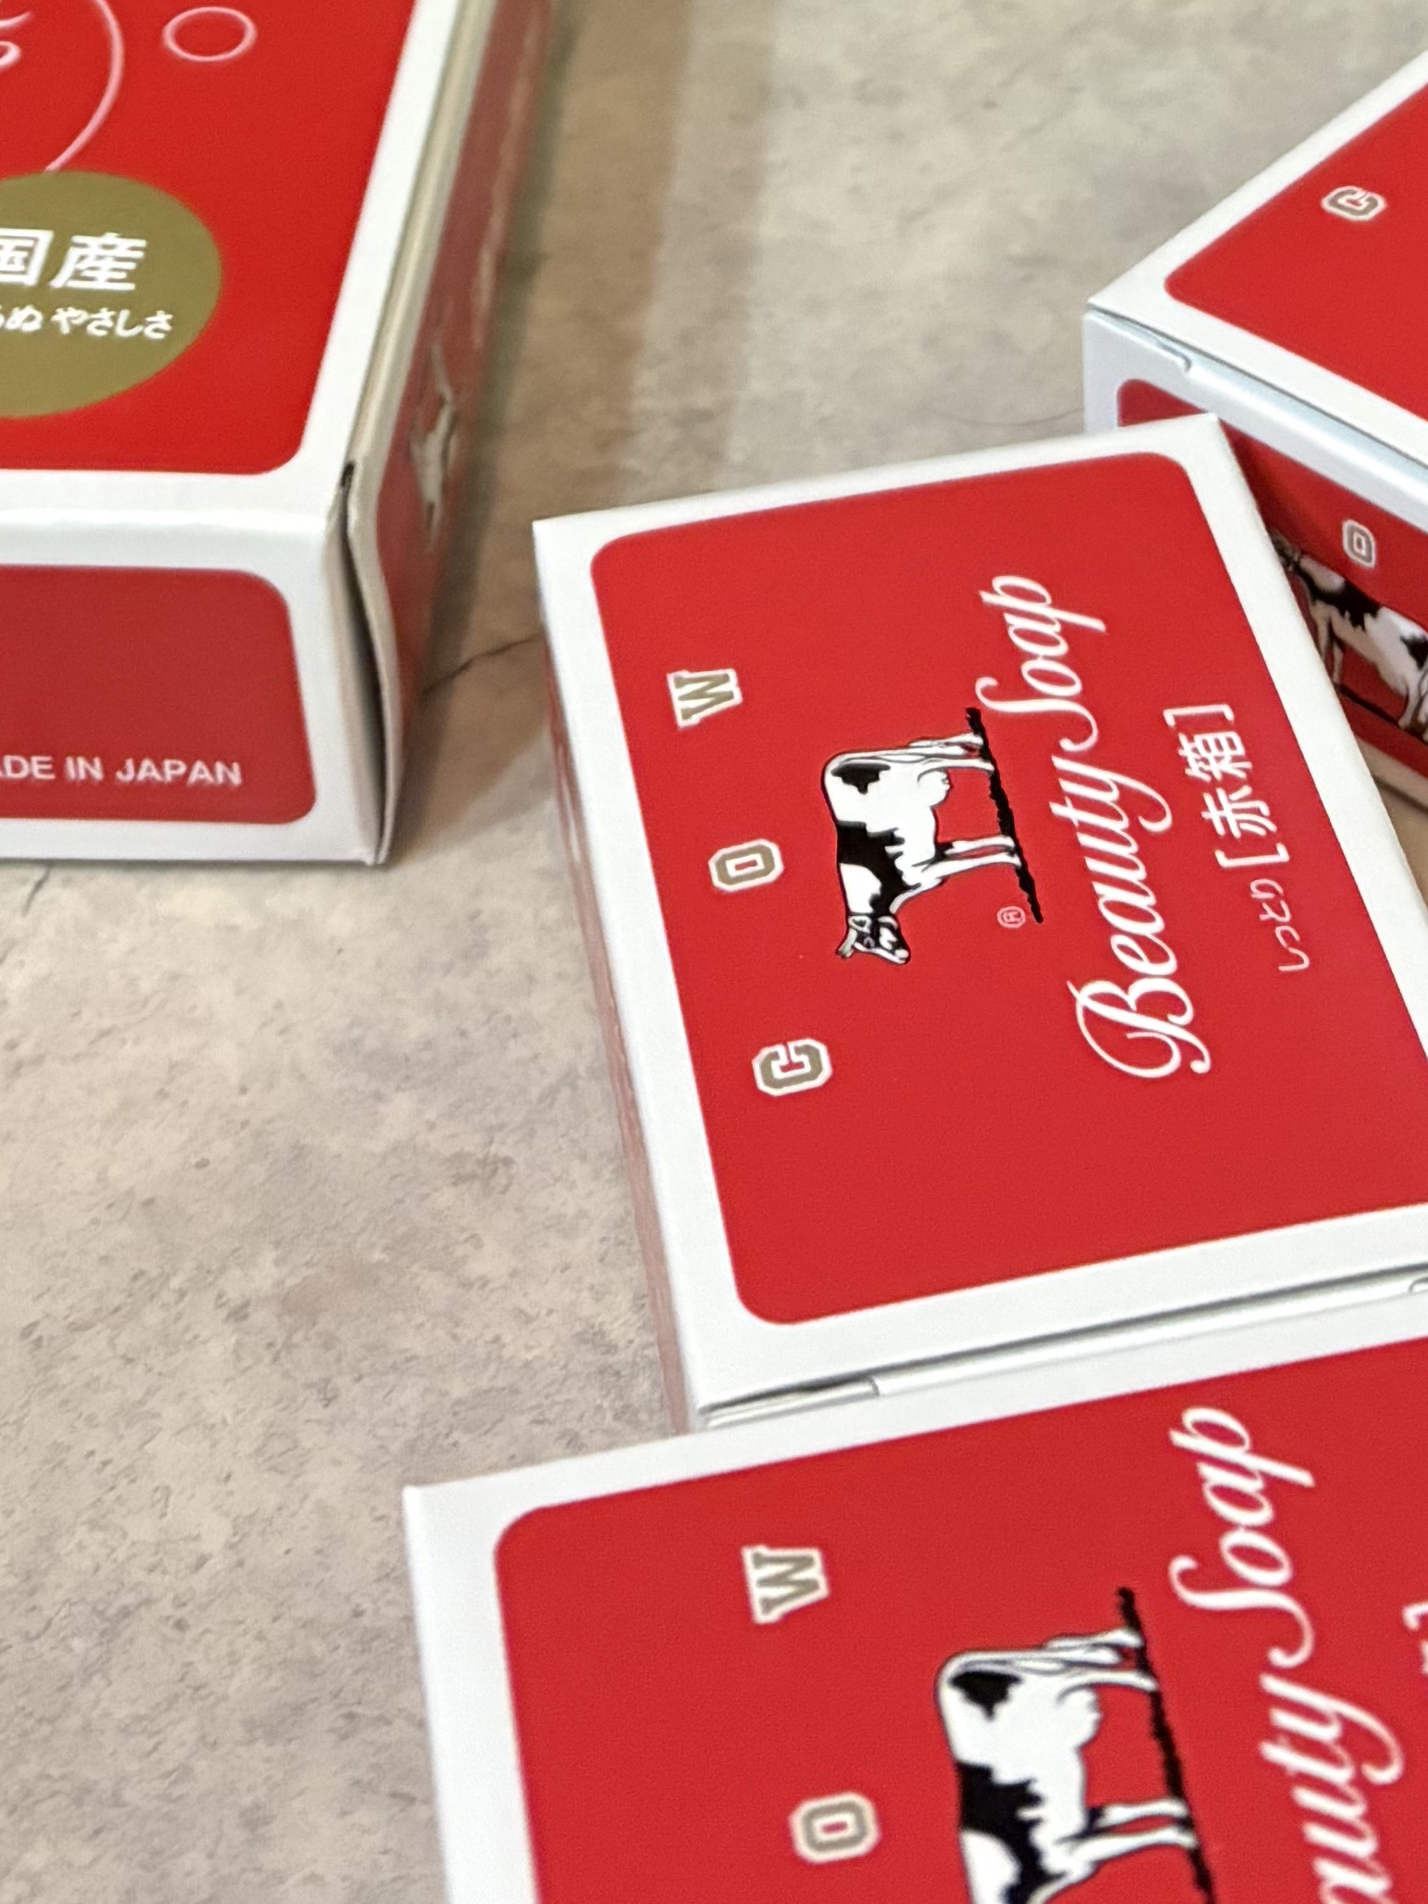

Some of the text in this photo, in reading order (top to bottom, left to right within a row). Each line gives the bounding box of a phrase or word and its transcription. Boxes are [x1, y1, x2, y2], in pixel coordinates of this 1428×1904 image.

[52, 307, 174, 339] やさしさ
[1320, 184, 1387, 222] C
[1342, 519, 1376, 568] O
[65, 756, 104, 782] IN
[116, 758, 243, 788] JAPAN
[667, 667, 834, 1097] C O W
[974, 574, 1212, 1080] Beauty Soap
[1163, 703, 1310, 972] しっとり [赤箱]
[1167, 1406, 1315, 1668] Soap
[741, 1545, 881, 1863] O W
